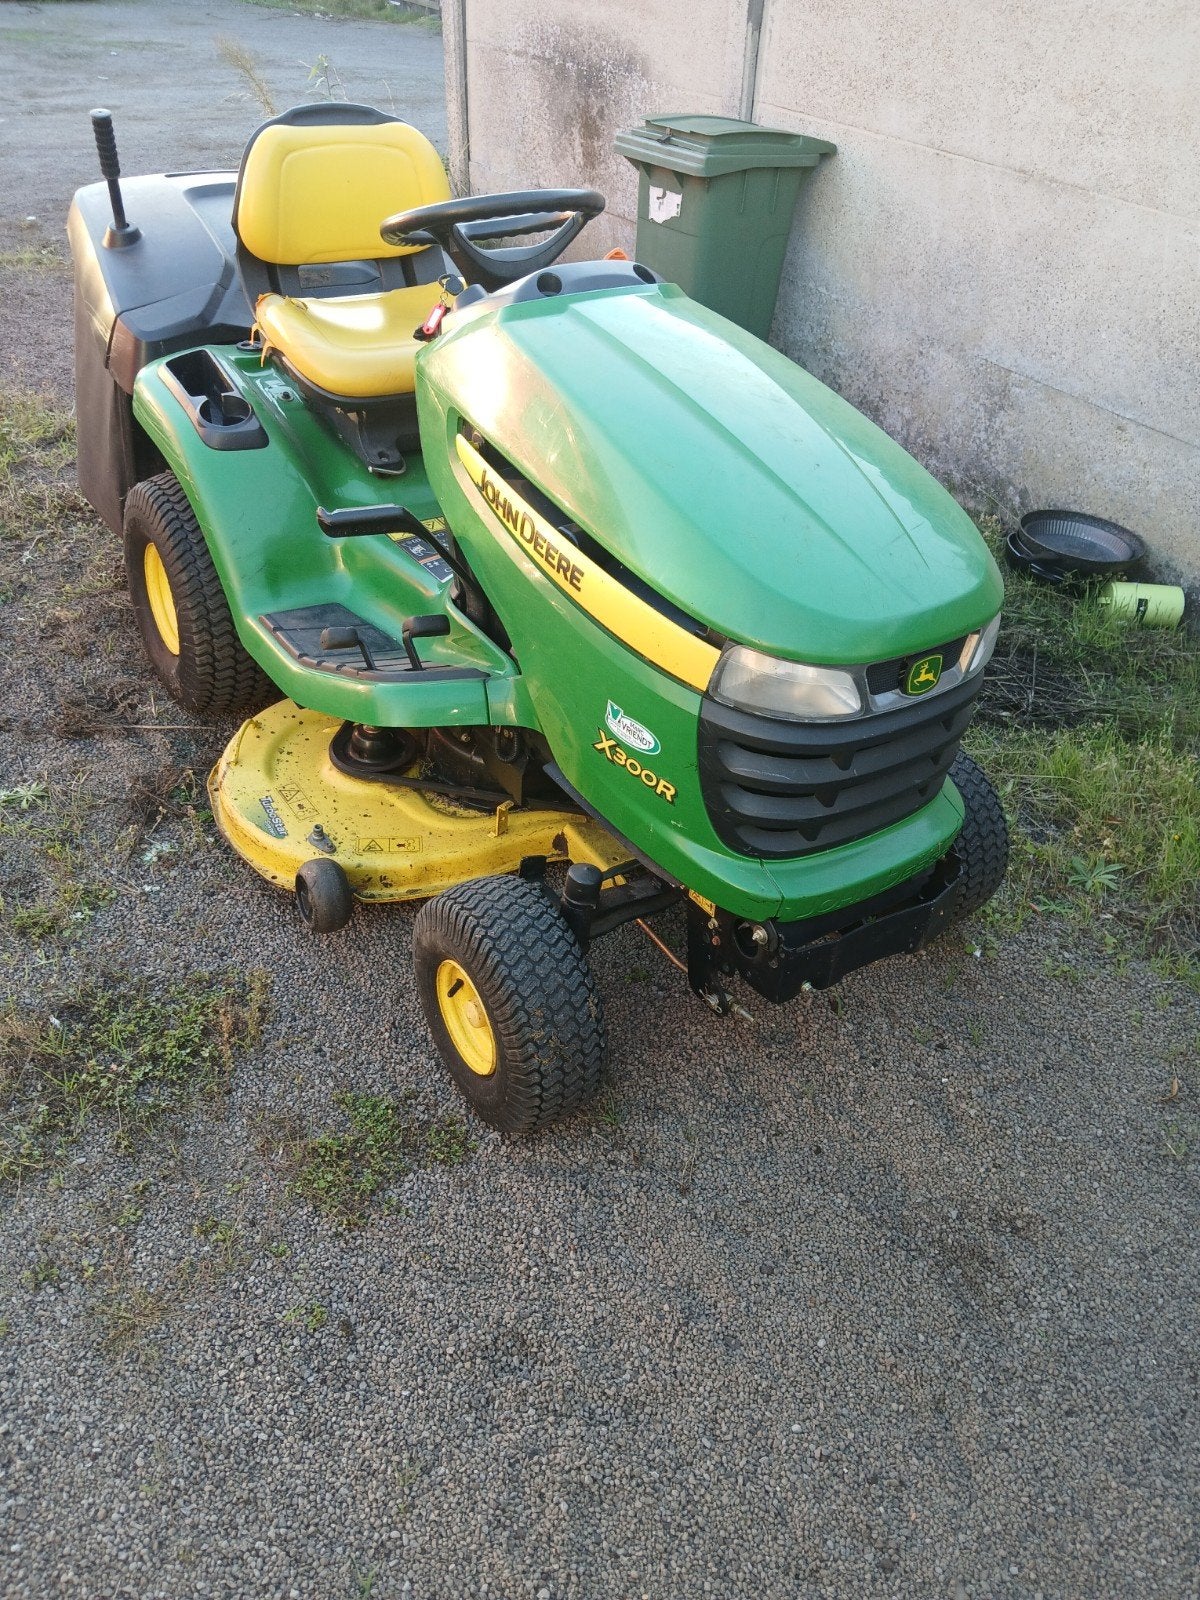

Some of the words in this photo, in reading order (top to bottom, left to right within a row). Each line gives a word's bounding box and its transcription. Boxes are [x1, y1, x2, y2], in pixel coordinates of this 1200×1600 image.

[477, 469, 519, 531] JOHN
[520, 512, 584, 592] DEERE
[593, 728, 677, 804] X300R
